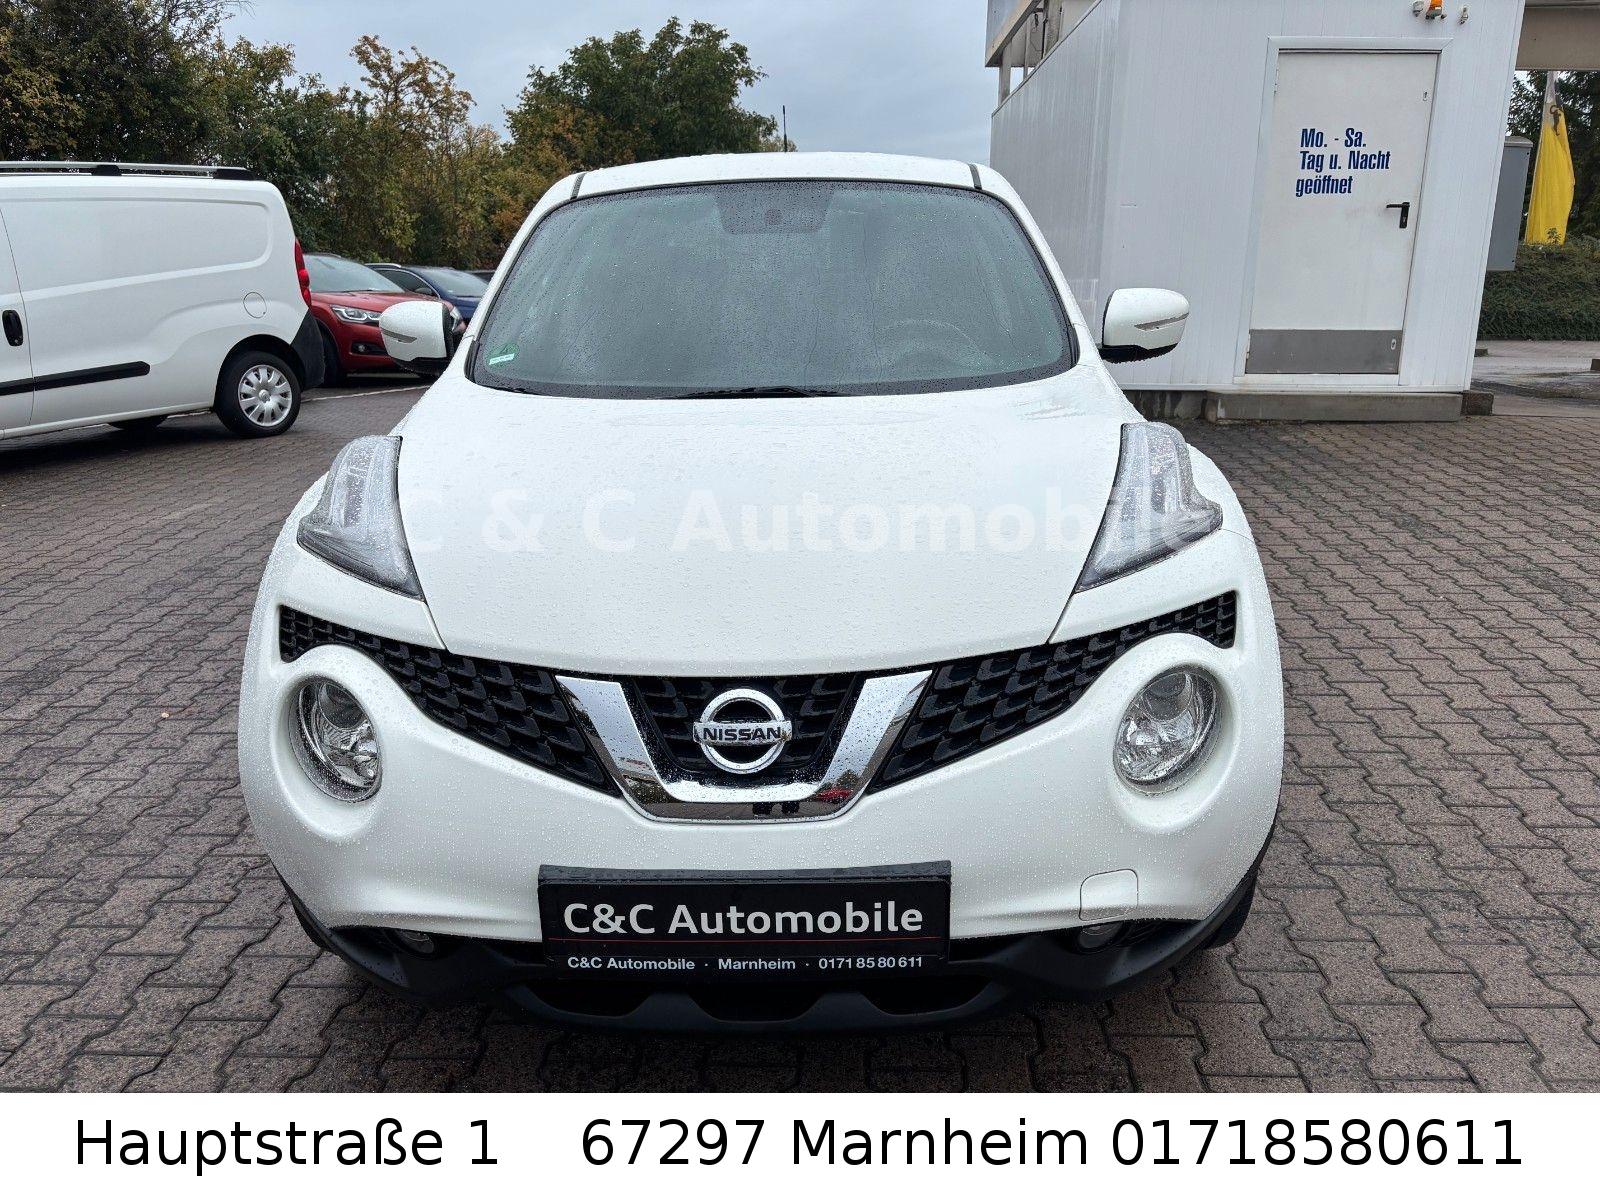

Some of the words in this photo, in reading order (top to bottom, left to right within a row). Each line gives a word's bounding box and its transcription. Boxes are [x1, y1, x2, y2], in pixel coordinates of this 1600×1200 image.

[1300, 128, 1328, 148] Mo.
[1344, 127, 1367, 148] Sa.
[1300, 150, 1325, 173] Tag
[1328, 154, 1342, 170] u.
[1347, 150, 1391, 170] Nacht
[1295, 175, 1354, 198] geöffnet
[703, 726, 782, 741] NISSAN
[563, 902, 656, 934] C&C
[667, 900, 923, 934] Automobile
[567, 956, 603, 969] C&C
[606, 957, 696, 970] Automobile
[718, 957, 796, 970] Marnheim
